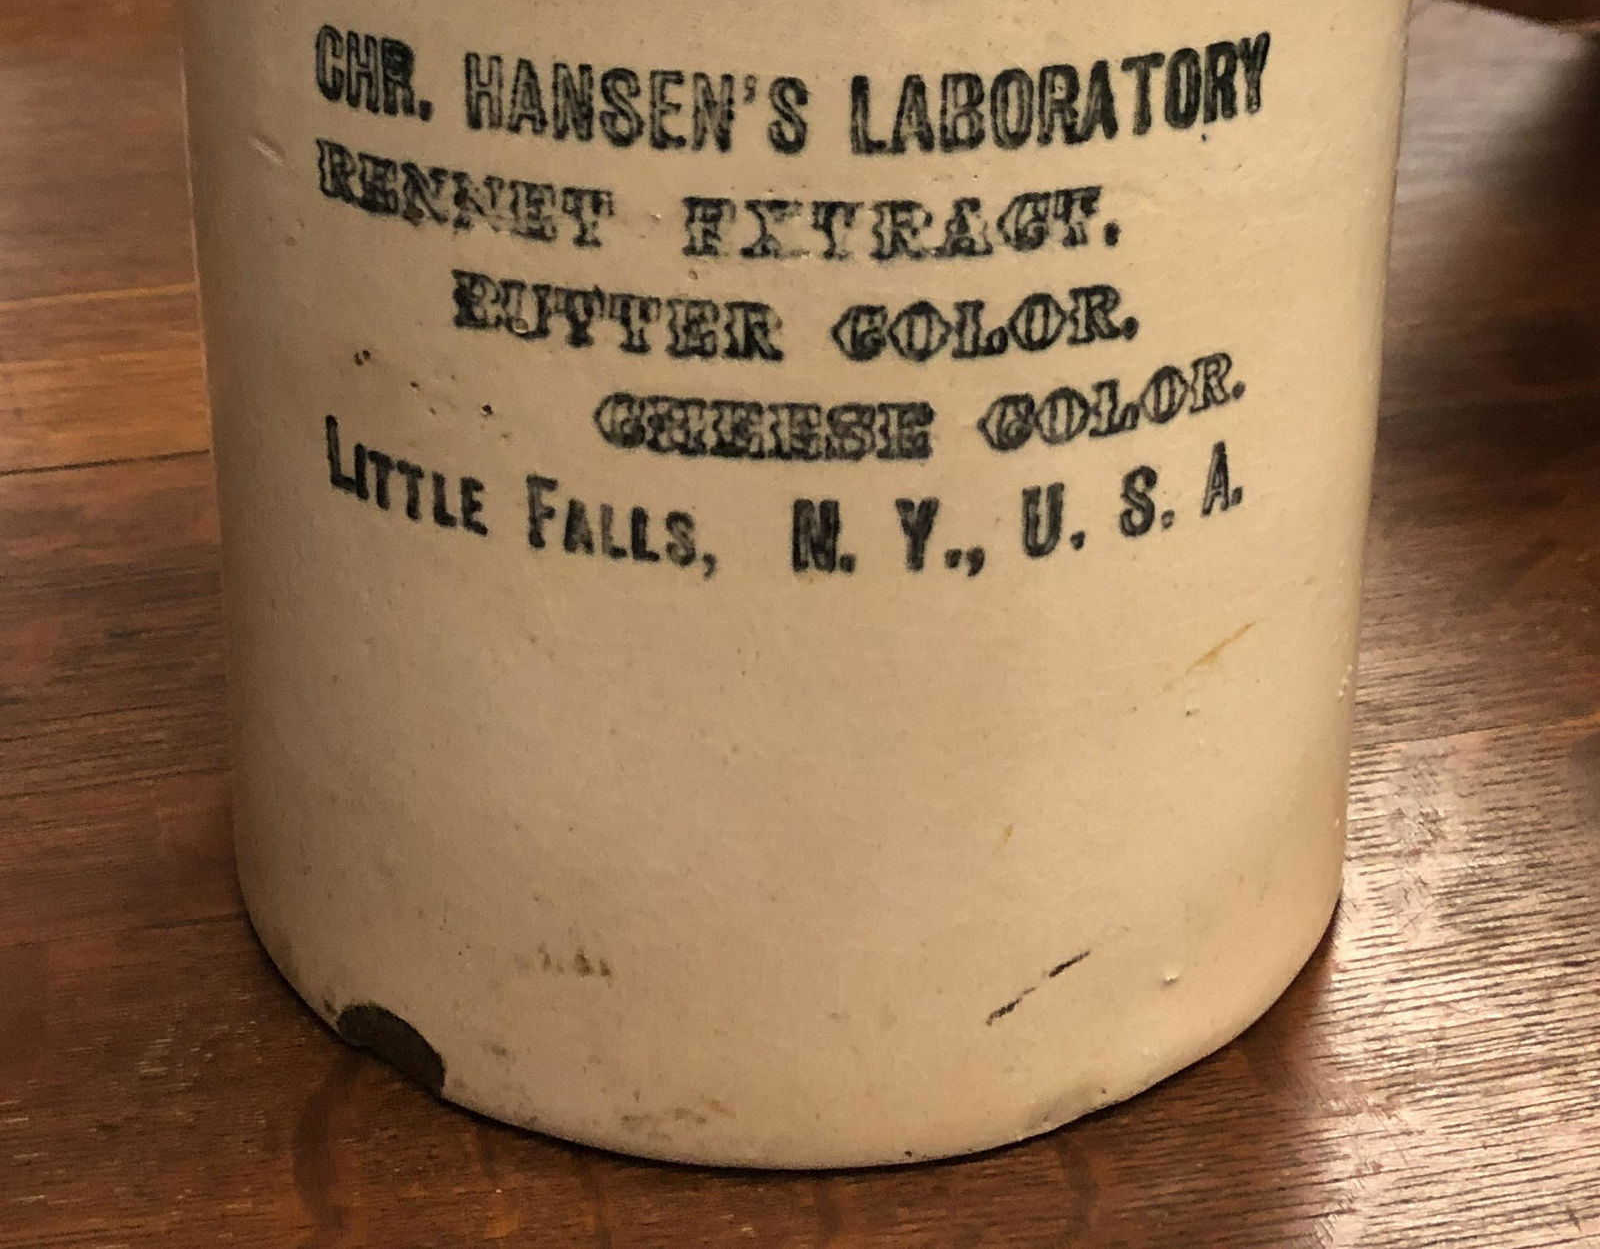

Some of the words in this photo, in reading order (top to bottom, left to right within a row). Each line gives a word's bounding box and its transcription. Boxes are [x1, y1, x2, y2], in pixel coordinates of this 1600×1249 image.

[315, 24, 433, 122] CHR.
[464, 51, 808, 154] HANSEN'S
[850, 30, 1271, 155] LABORATORY
[316, 139, 615, 248] RENNET
[832, 284, 1139, 361] COLOR.
[594, 391, 935, 460] CHEESE
[978, 352, 1246, 451] COLOR.
[793, 498, 857, 574] N.
[896, 497, 986, 577] Y.,
[1022, 482, 1086, 558] U.
[1120, 466, 1175, 537] S.
[1202, 441, 1243, 518] A.
